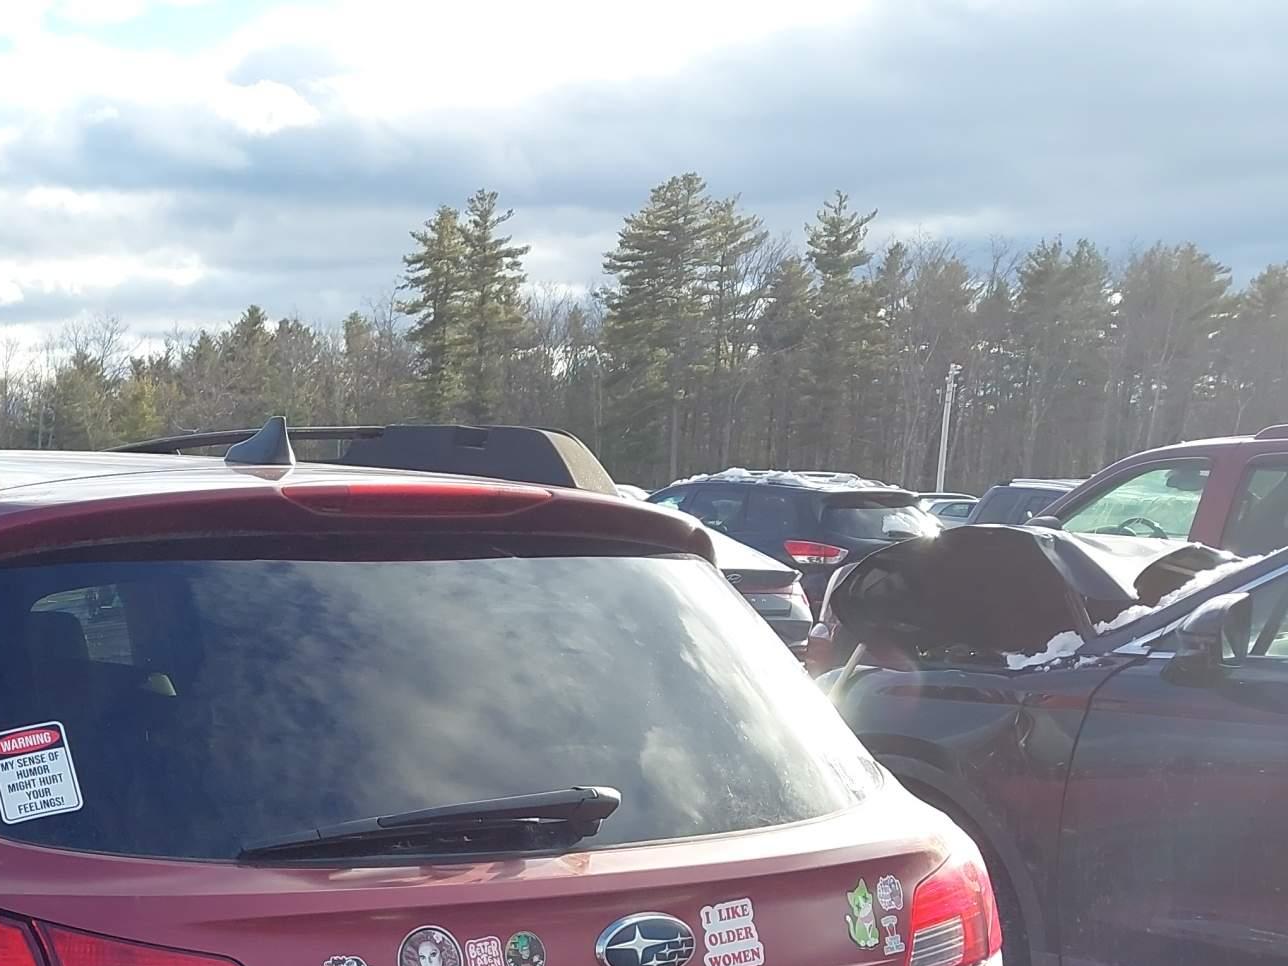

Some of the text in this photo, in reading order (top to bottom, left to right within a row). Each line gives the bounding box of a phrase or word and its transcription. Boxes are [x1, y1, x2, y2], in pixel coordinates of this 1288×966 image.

[0, 732, 52, 753] WARNING
[0, 751, 59, 772] MY SENSE OF
[16, 764, 50, 780] HUMOR
[7, 773, 63, 794] MIGHT HURT
[25, 787, 52, 801] YOUR
[17, 796, 64, 814] FEELINGS!
[705, 904, 750, 925] I LIKE
[708, 926, 754, 947] OLDER
[469, 940, 499, 958] BETTER
